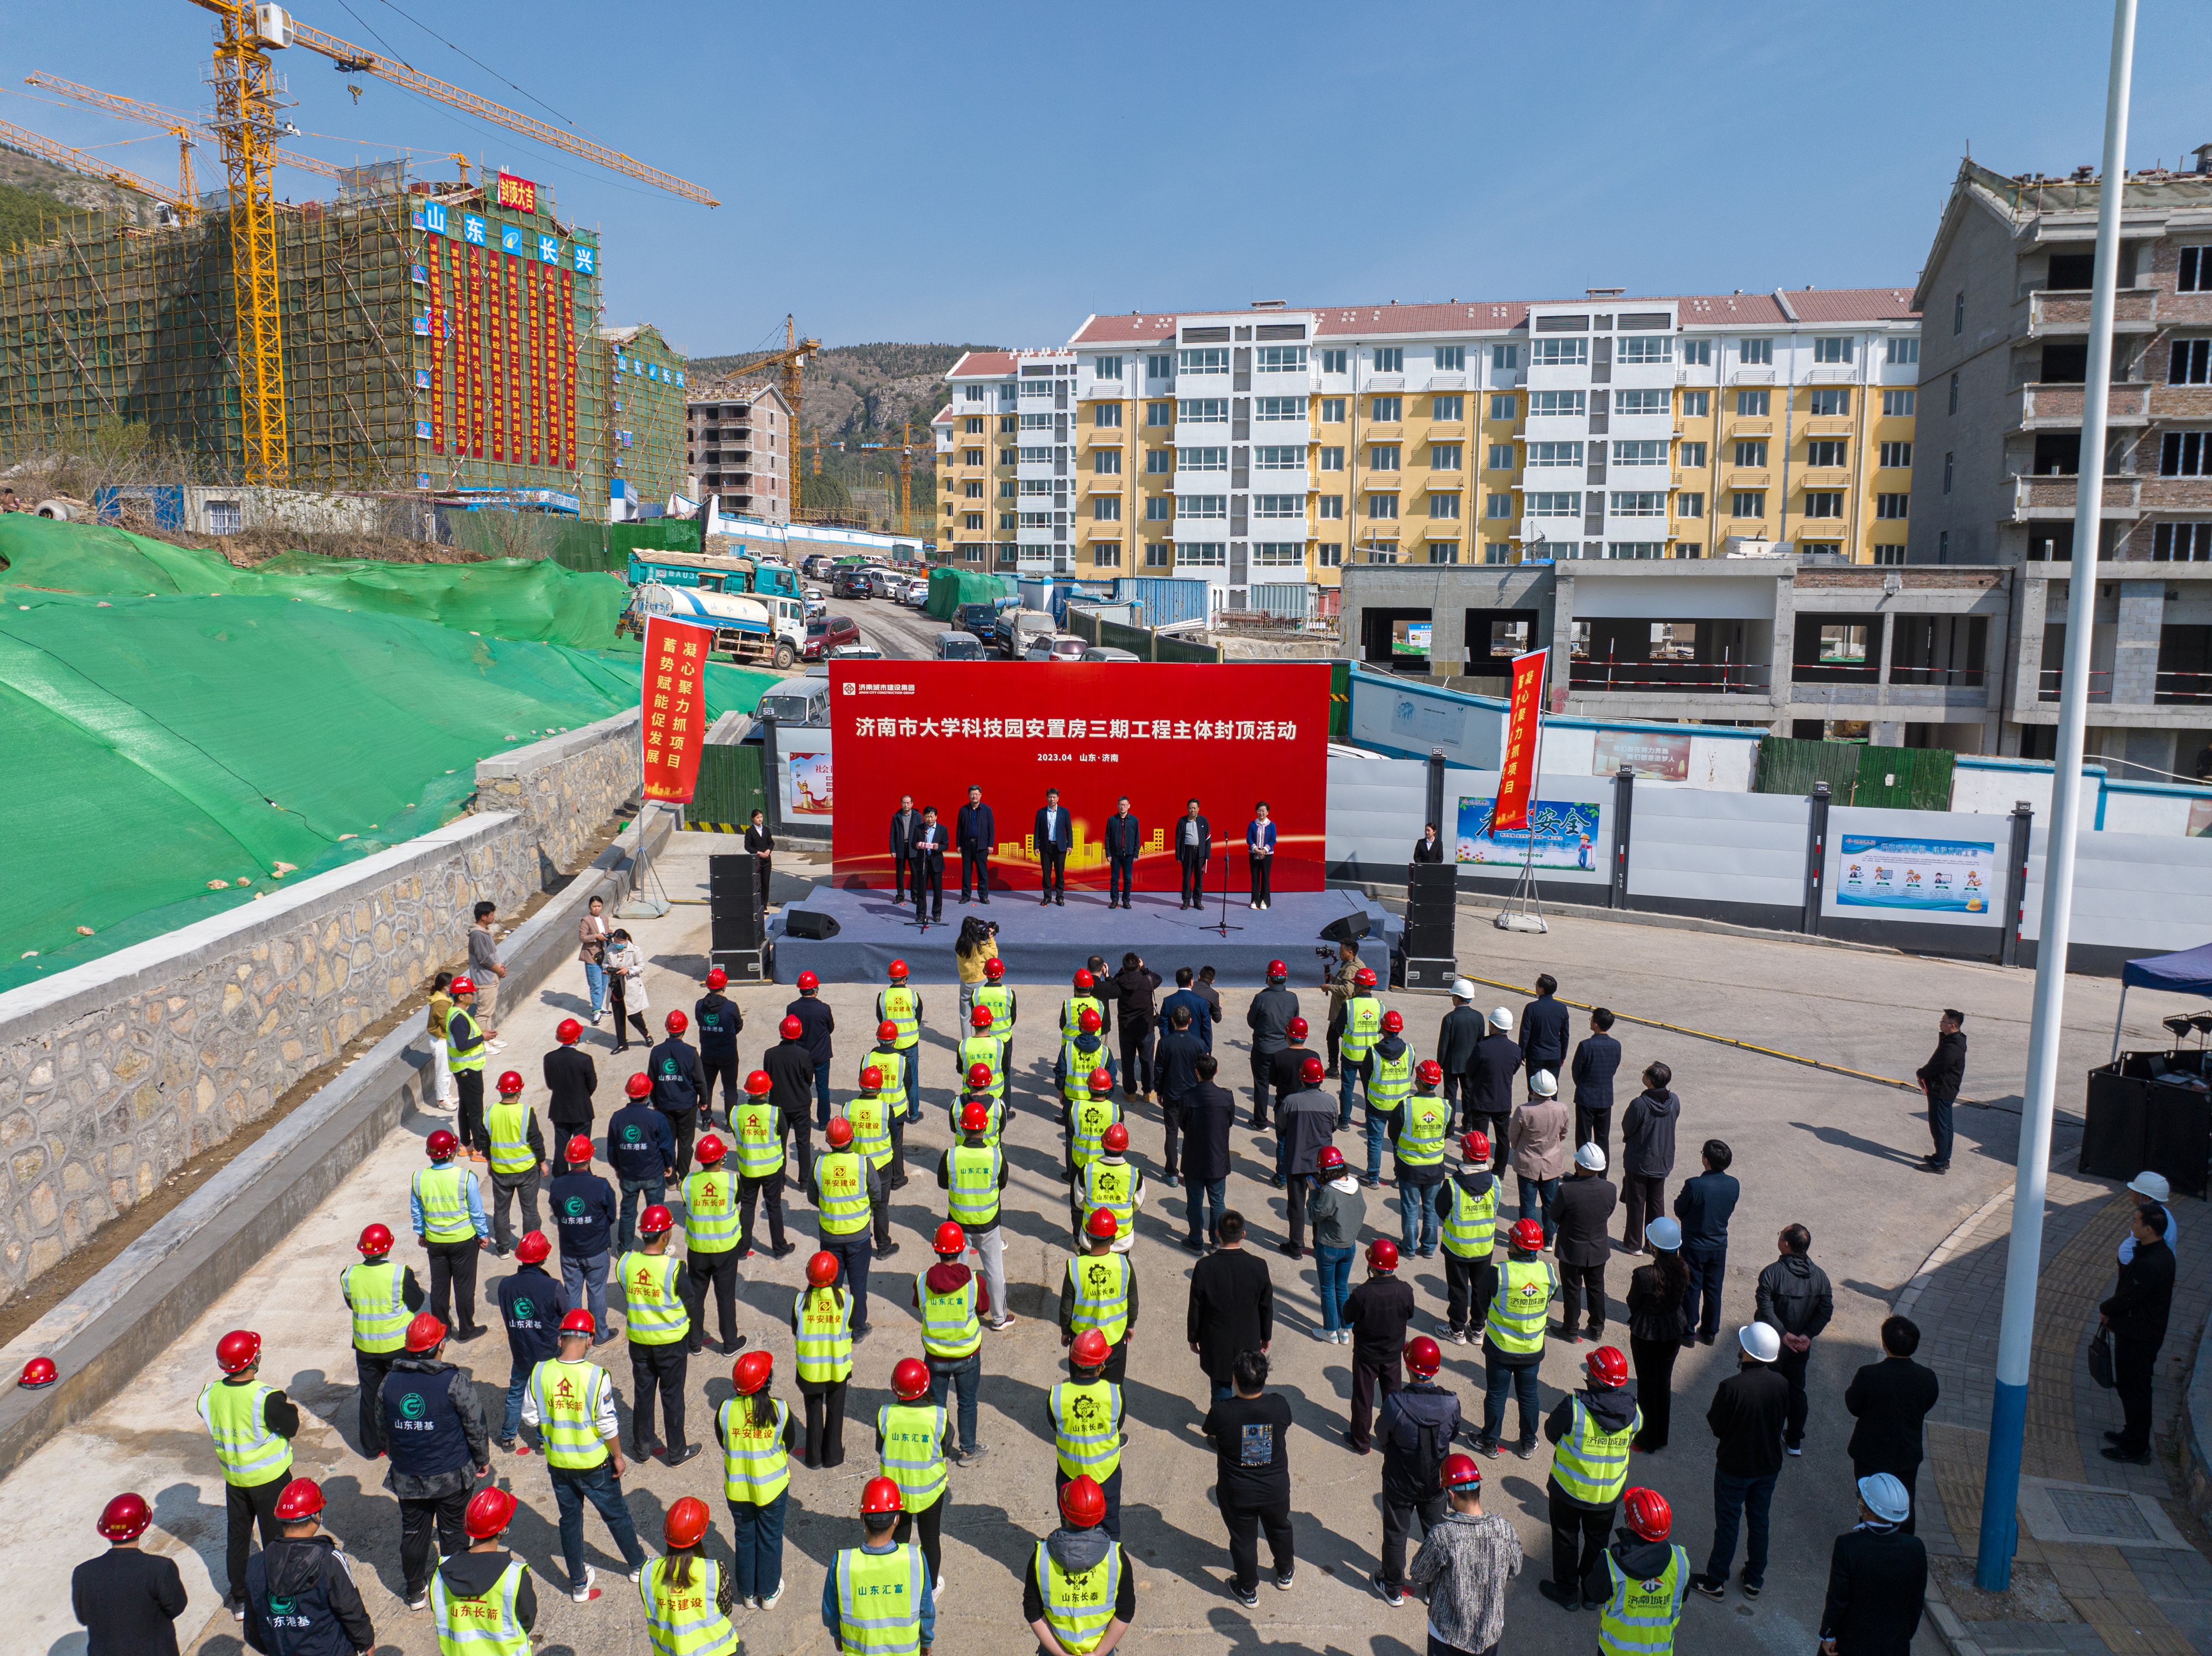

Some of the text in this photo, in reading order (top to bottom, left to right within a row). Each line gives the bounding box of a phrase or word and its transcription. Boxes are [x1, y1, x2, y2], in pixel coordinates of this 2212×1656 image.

[501, 179, 534, 210] 封顶大吉
[646, 638, 677, 764] 蓄势赋能促发展
[667, 642, 697, 769] 凝心聚力抓项目
[855, 717, 1297, 740] 济南市大学科技园安置房三期工程主体封顶活动
[1504, 670, 1534, 793] 凝心聚力抓项目
[1613, 745, 1669, 755] 我们都在努力奔跑
[1079, 753, 1119, 762] 山东·济南
[1627, 754, 1675, 762] 我们都是追梦人
[561, 1216, 592, 1225] 山东港基
[509, 1319, 542, 1329] 山东港基
[395, 1419, 435, 1430] 山东港基
[1073, 1423, 1104, 1432] 山东长泰
[732, 1428, 773, 1439] 平安建设
[892, 1433, 929, 1443] 山东汇富
[1587, 1436, 1627, 1446] 济南城建
[858, 1584, 903, 1596] 山东汇富
[1062, 1592, 1099, 1602] 山东长泰
[1627, 1594, 1670, 1605] 济南城建
[657, 1597, 702, 1612] 平安建设
[451, 1605, 498, 1620] 山东长箭
